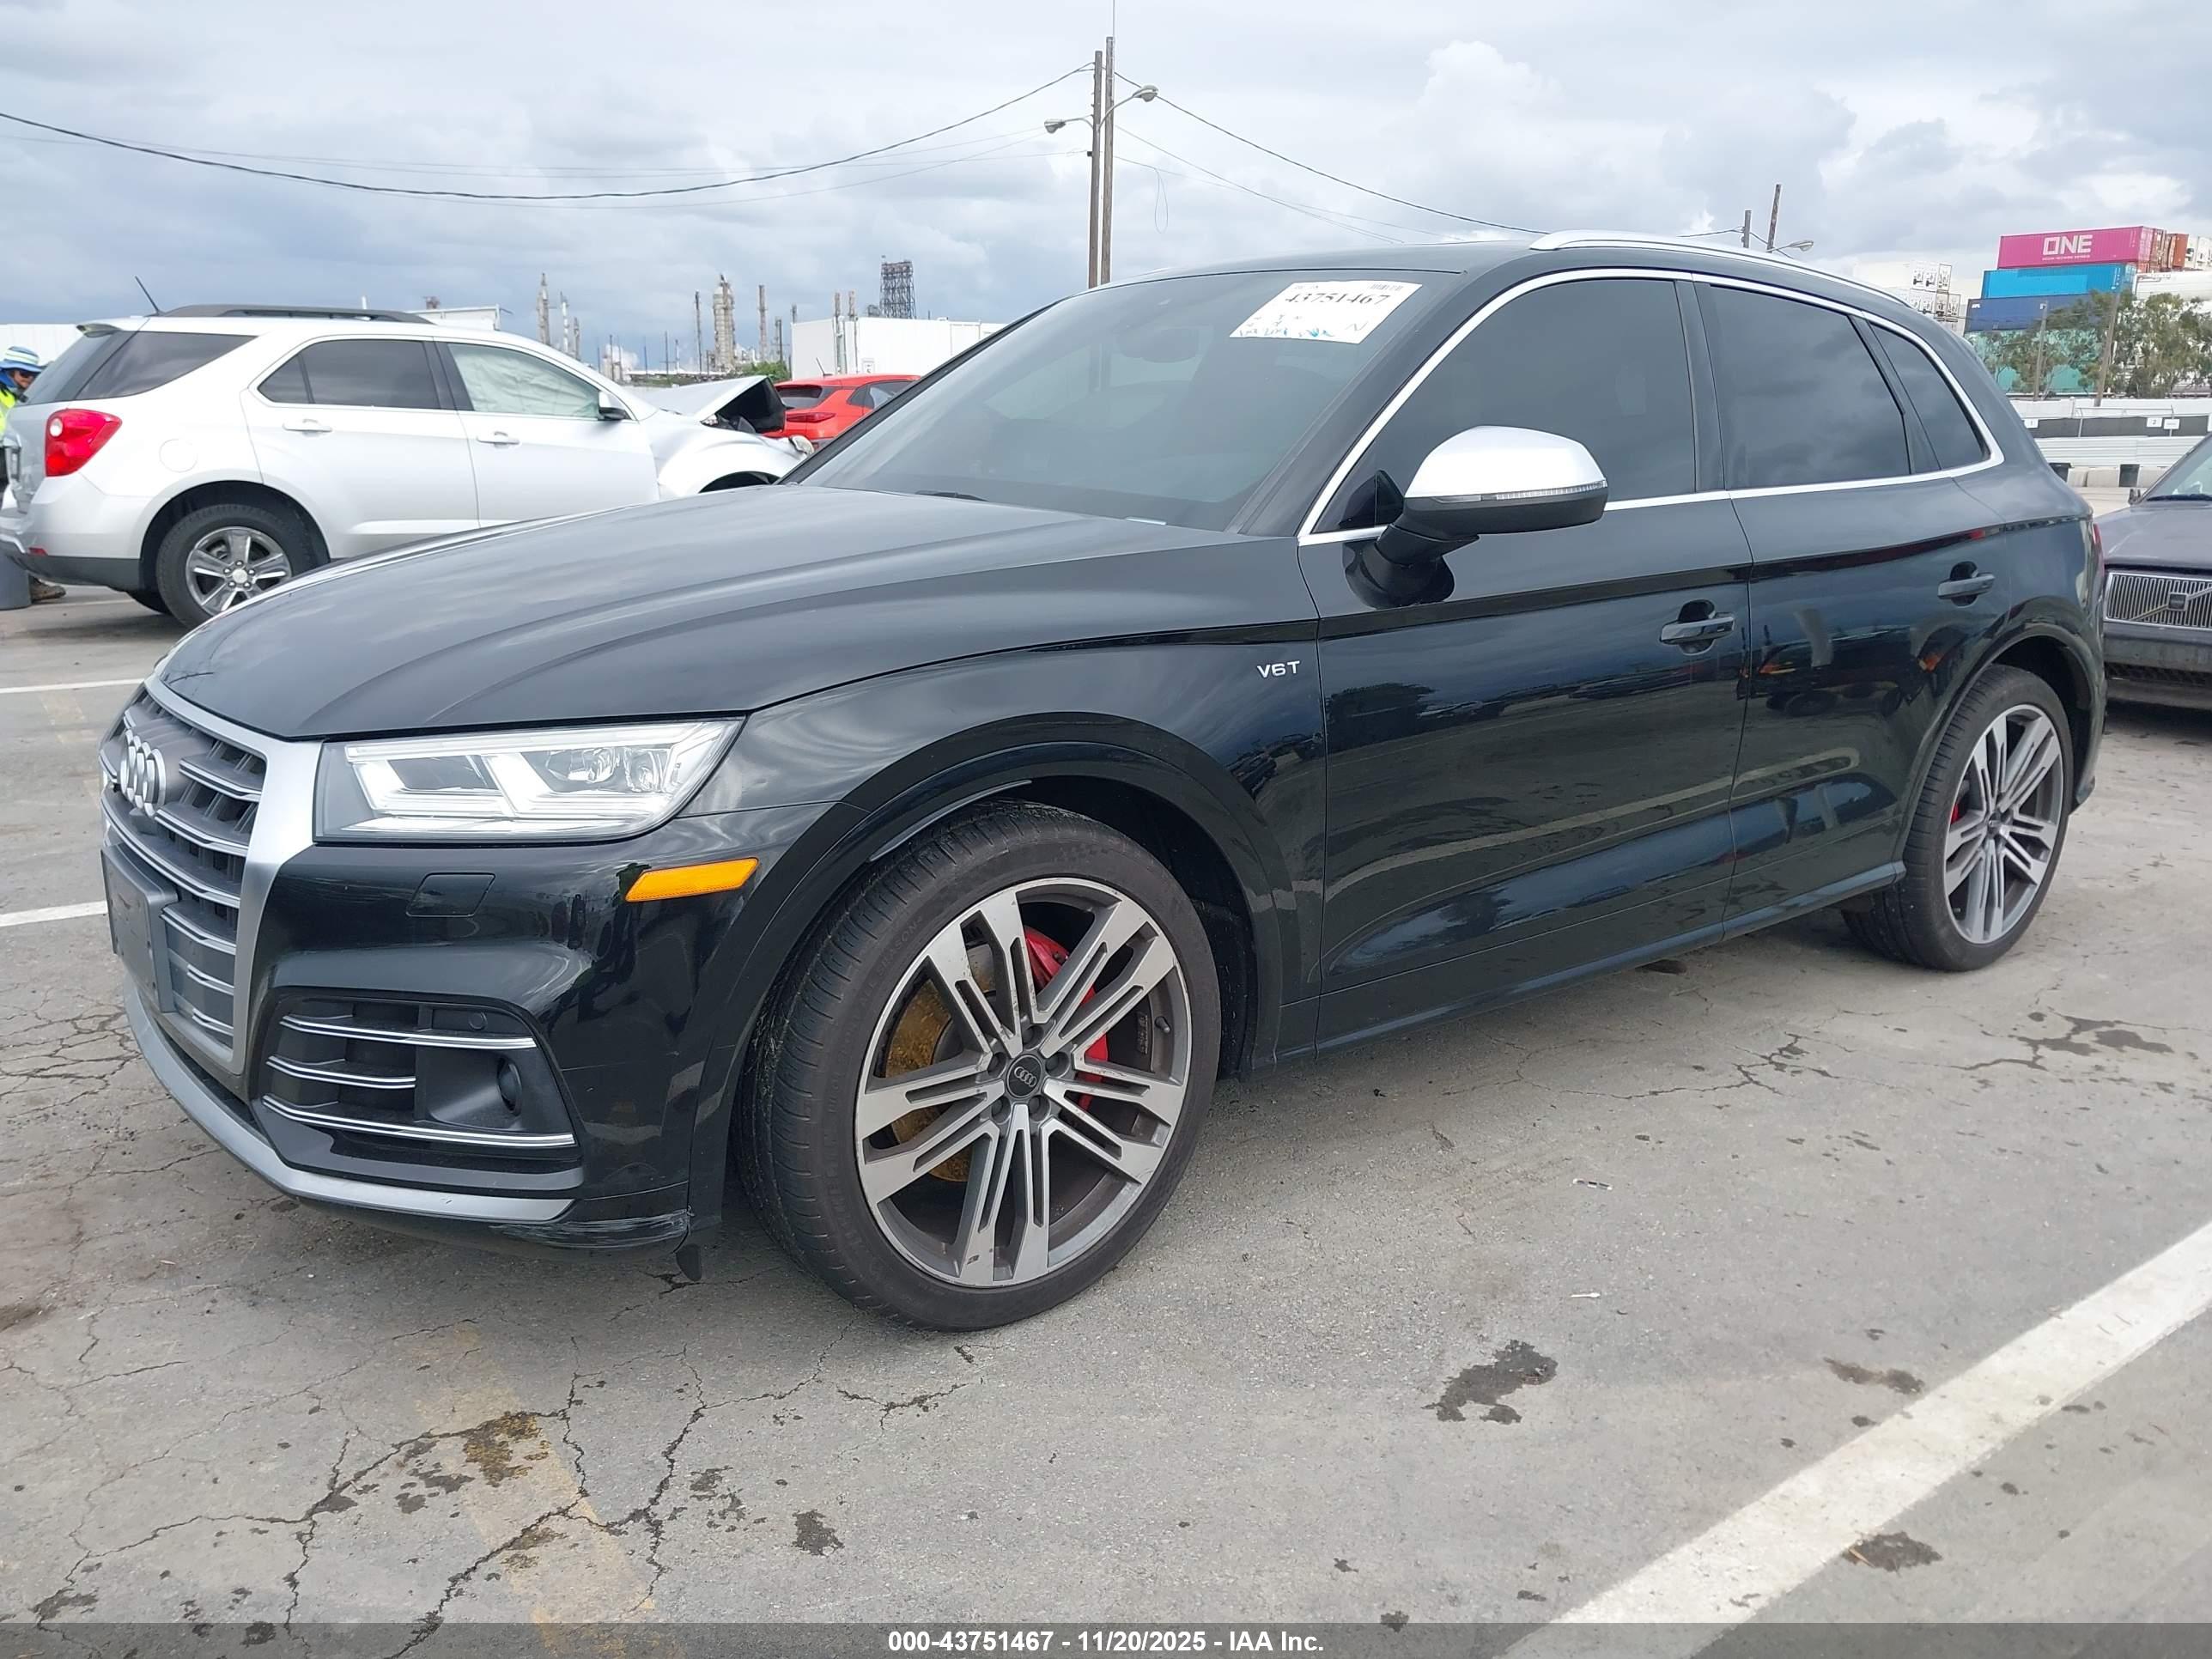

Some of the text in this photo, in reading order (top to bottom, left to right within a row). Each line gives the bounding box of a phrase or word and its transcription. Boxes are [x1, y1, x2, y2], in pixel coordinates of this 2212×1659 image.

[2043, 234, 2093, 255] ONE
[1285, 293, 1390, 305] 43751467
[1256, 660, 1300, 678] V6T
